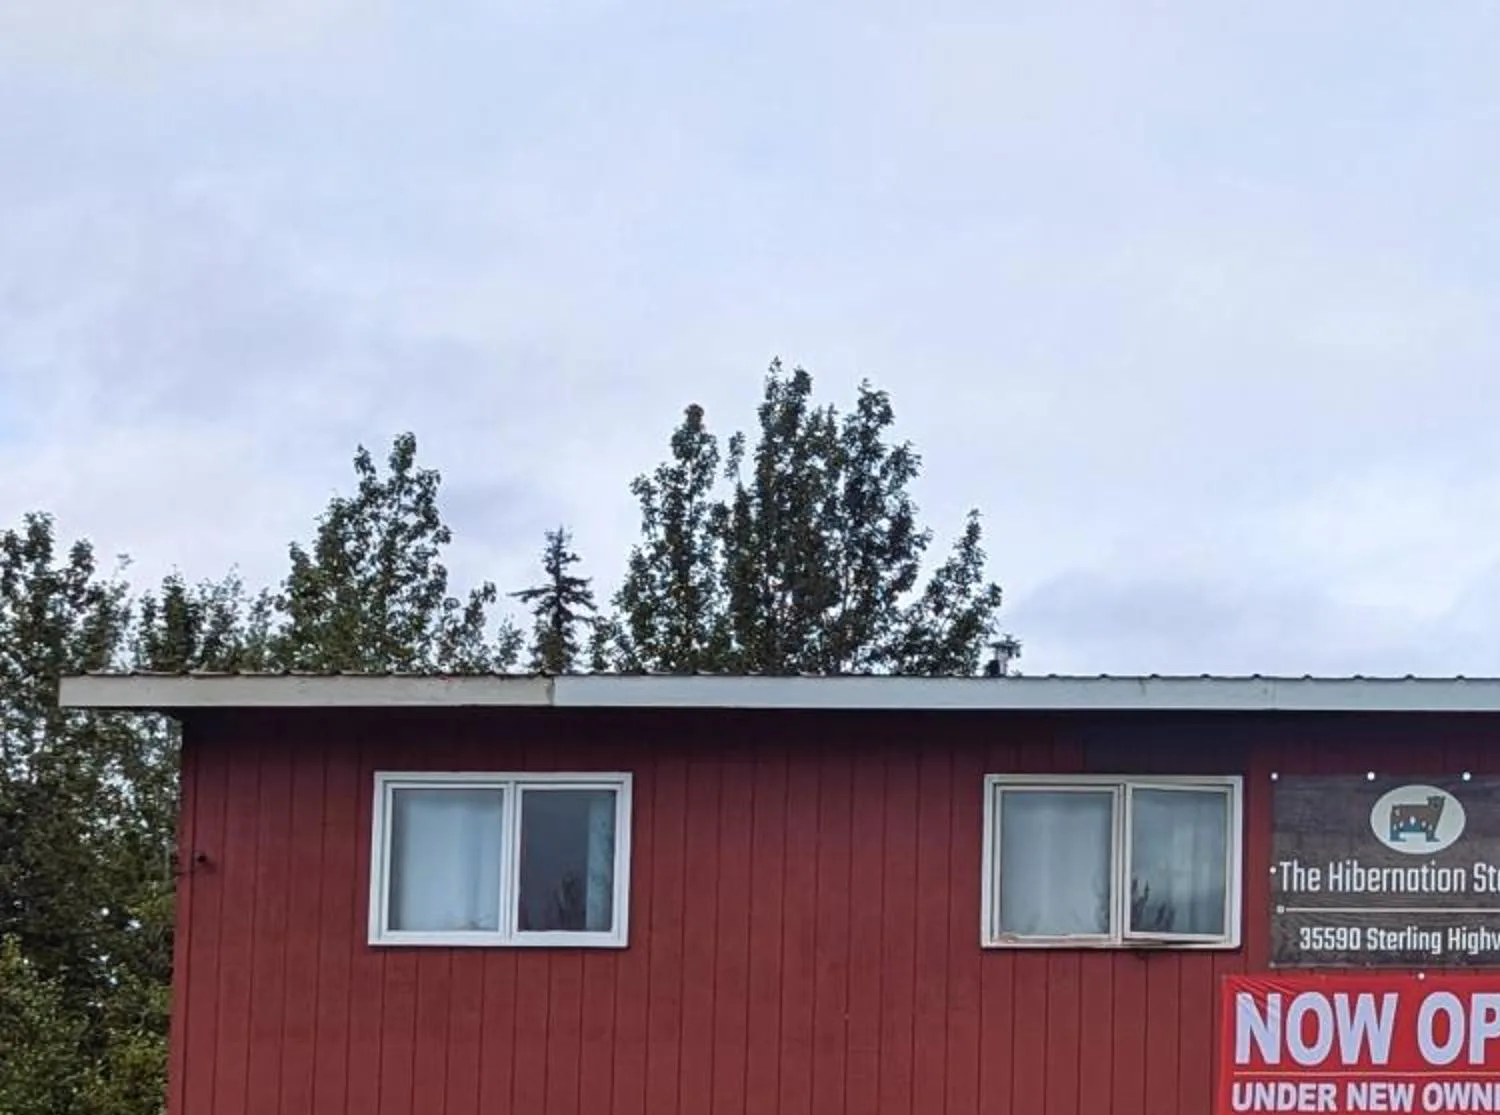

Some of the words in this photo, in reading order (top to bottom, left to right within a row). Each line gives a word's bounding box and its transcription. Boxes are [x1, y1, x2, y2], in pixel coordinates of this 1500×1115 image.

[1279, 861, 1321, 893] The
[1329, 860, 1466, 893] Hibernation
[1299, 927, 1361, 951] 35590
[1367, 927, 1441, 955] Sterling
[1235, 992, 1399, 1065] NOW
[1232, 1082, 1337, 1112] UNDER
[1347, 1083, 1414, 1112] NEW
